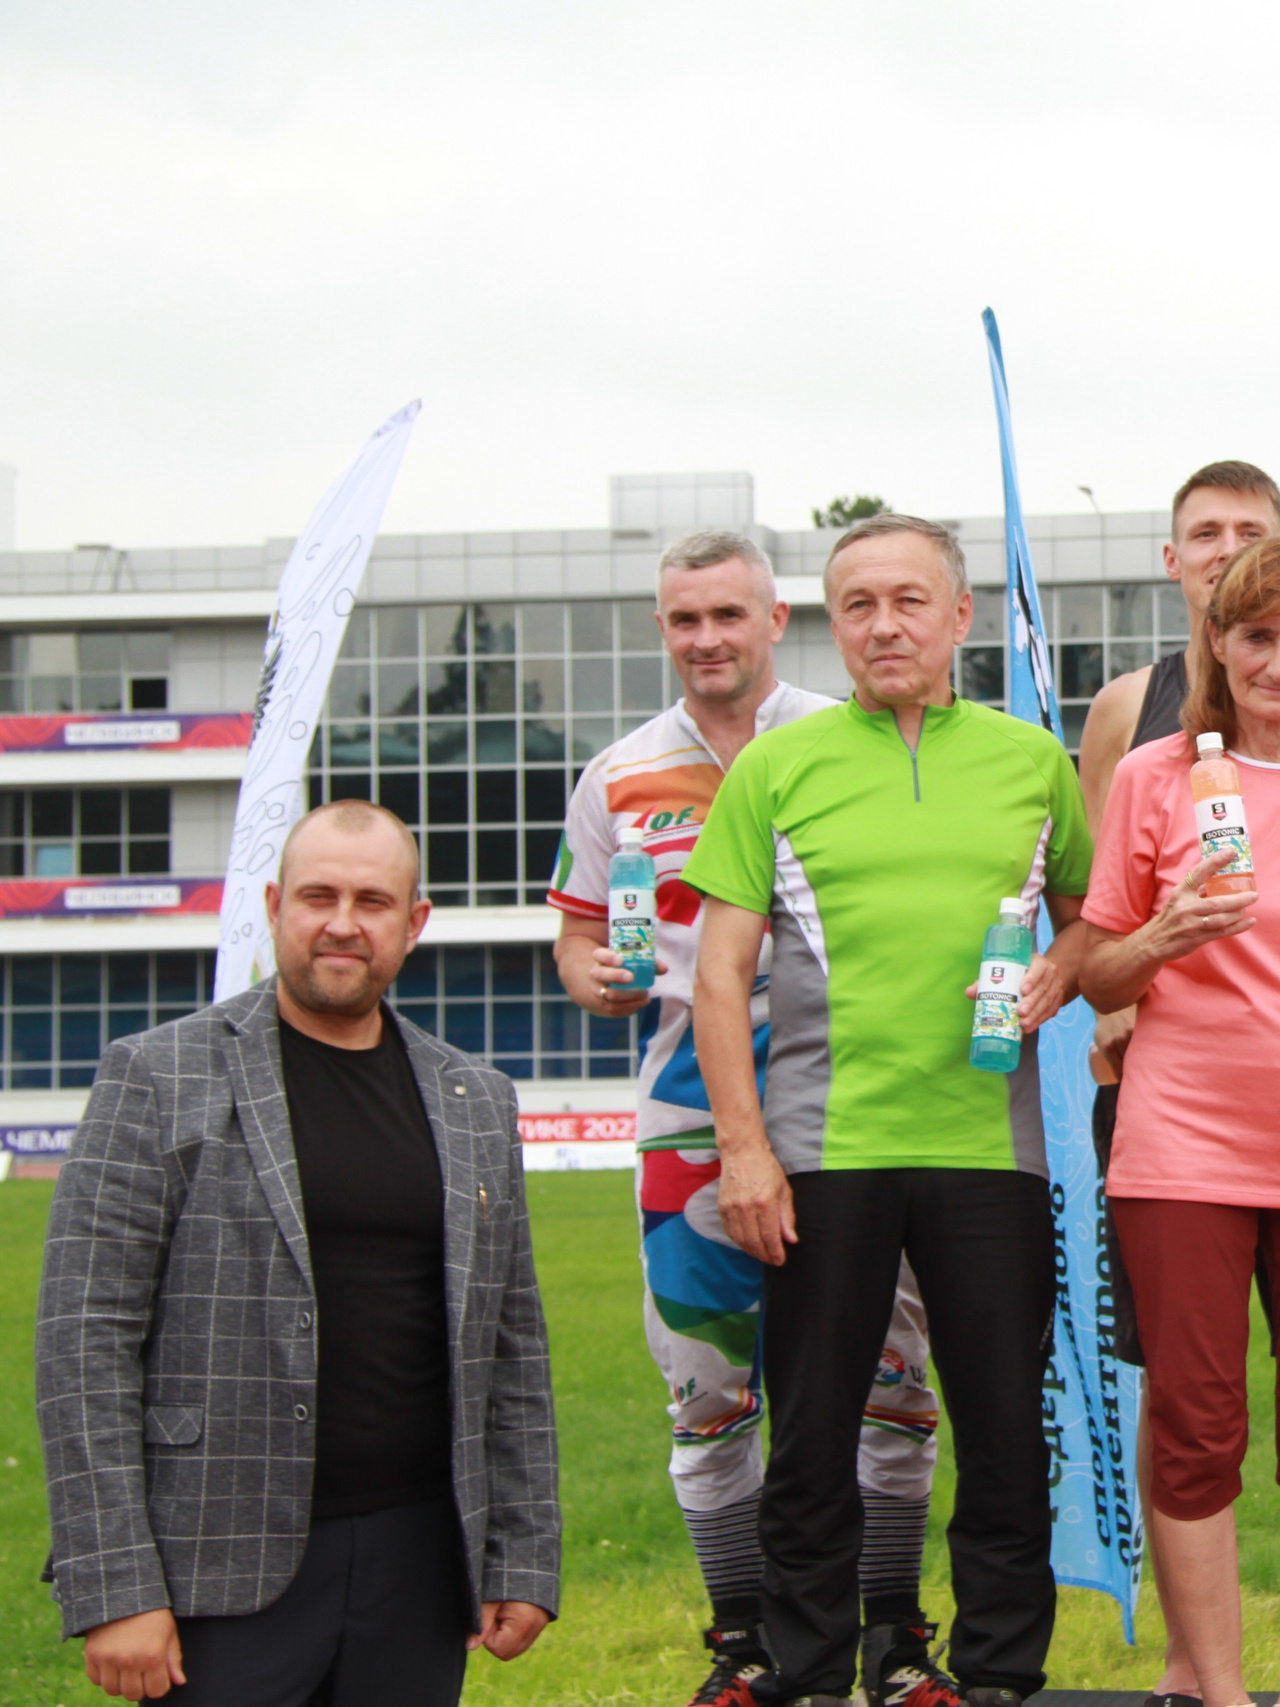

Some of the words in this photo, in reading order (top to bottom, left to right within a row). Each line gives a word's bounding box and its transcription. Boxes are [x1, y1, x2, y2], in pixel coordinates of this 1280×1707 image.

[1205, 828, 1241, 840] ISOTONIC
[614, 919, 647, 927] ISOTONIC
[980, 992, 1013, 1002] ISOTONIC
[582, 1117, 637, 1140] 202
